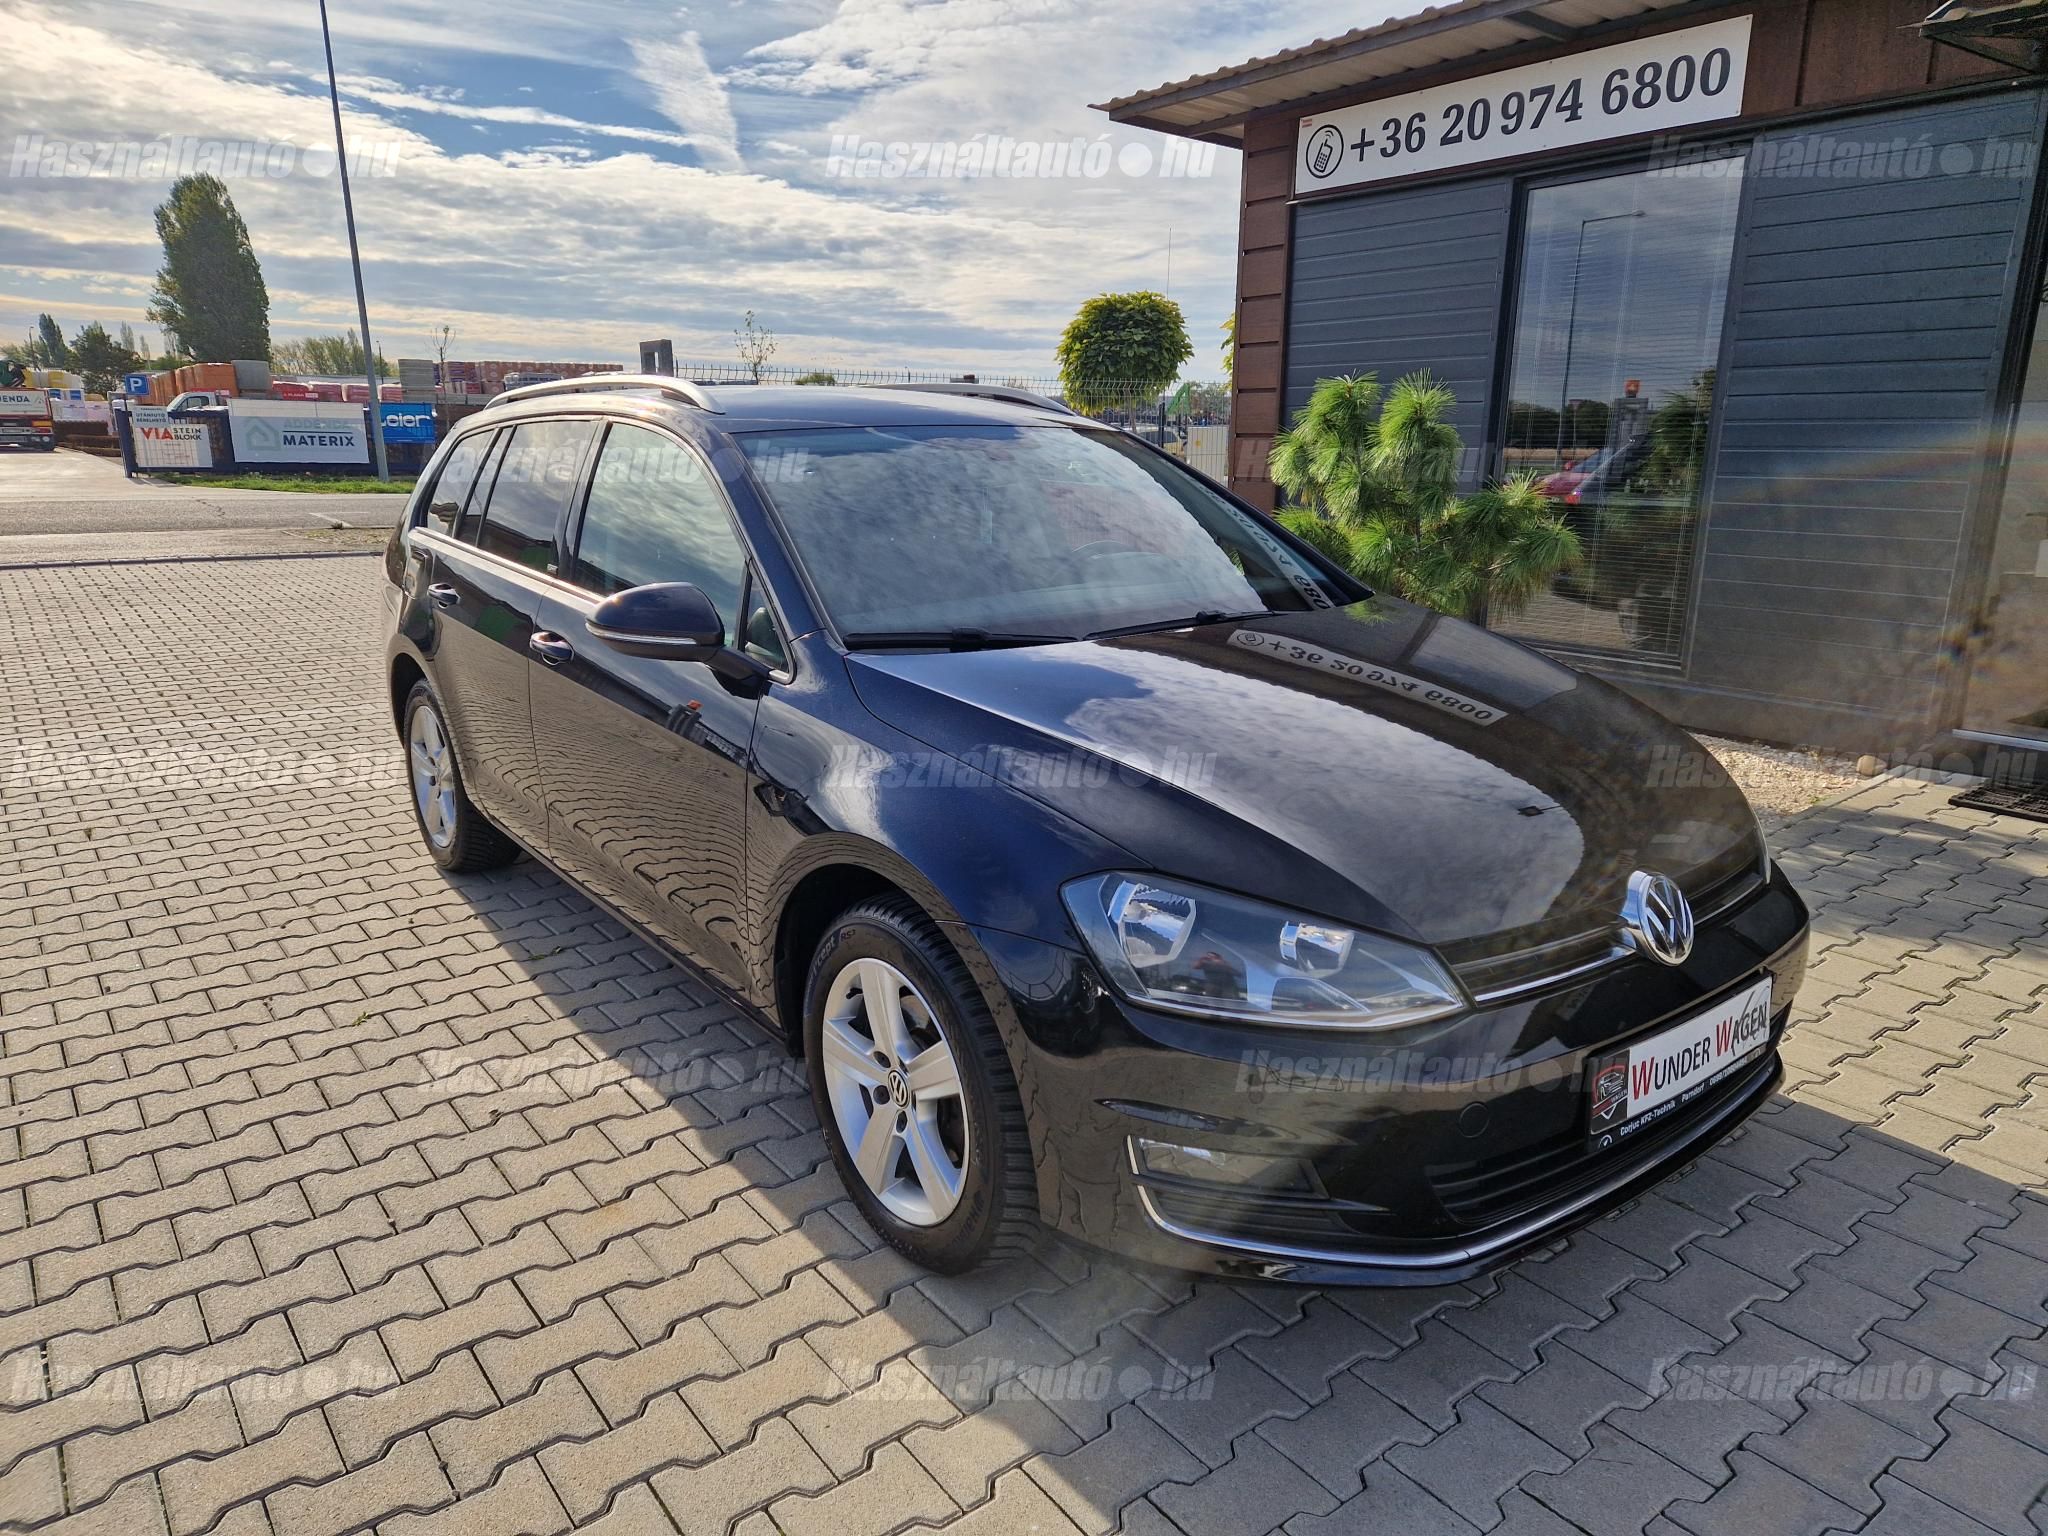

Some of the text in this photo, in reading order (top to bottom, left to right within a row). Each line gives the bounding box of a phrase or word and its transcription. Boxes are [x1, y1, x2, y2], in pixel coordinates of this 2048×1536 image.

[1350, 47, 1732, 162] +36 20 974 6800
[129, 377, 143, 392] P
[140, 427, 174, 440] VIA
[282, 433, 356, 448] MATERIX
[1632, 1037, 1711, 1101] WUNDER
[1715, 1001, 1768, 1057] WAGEN
